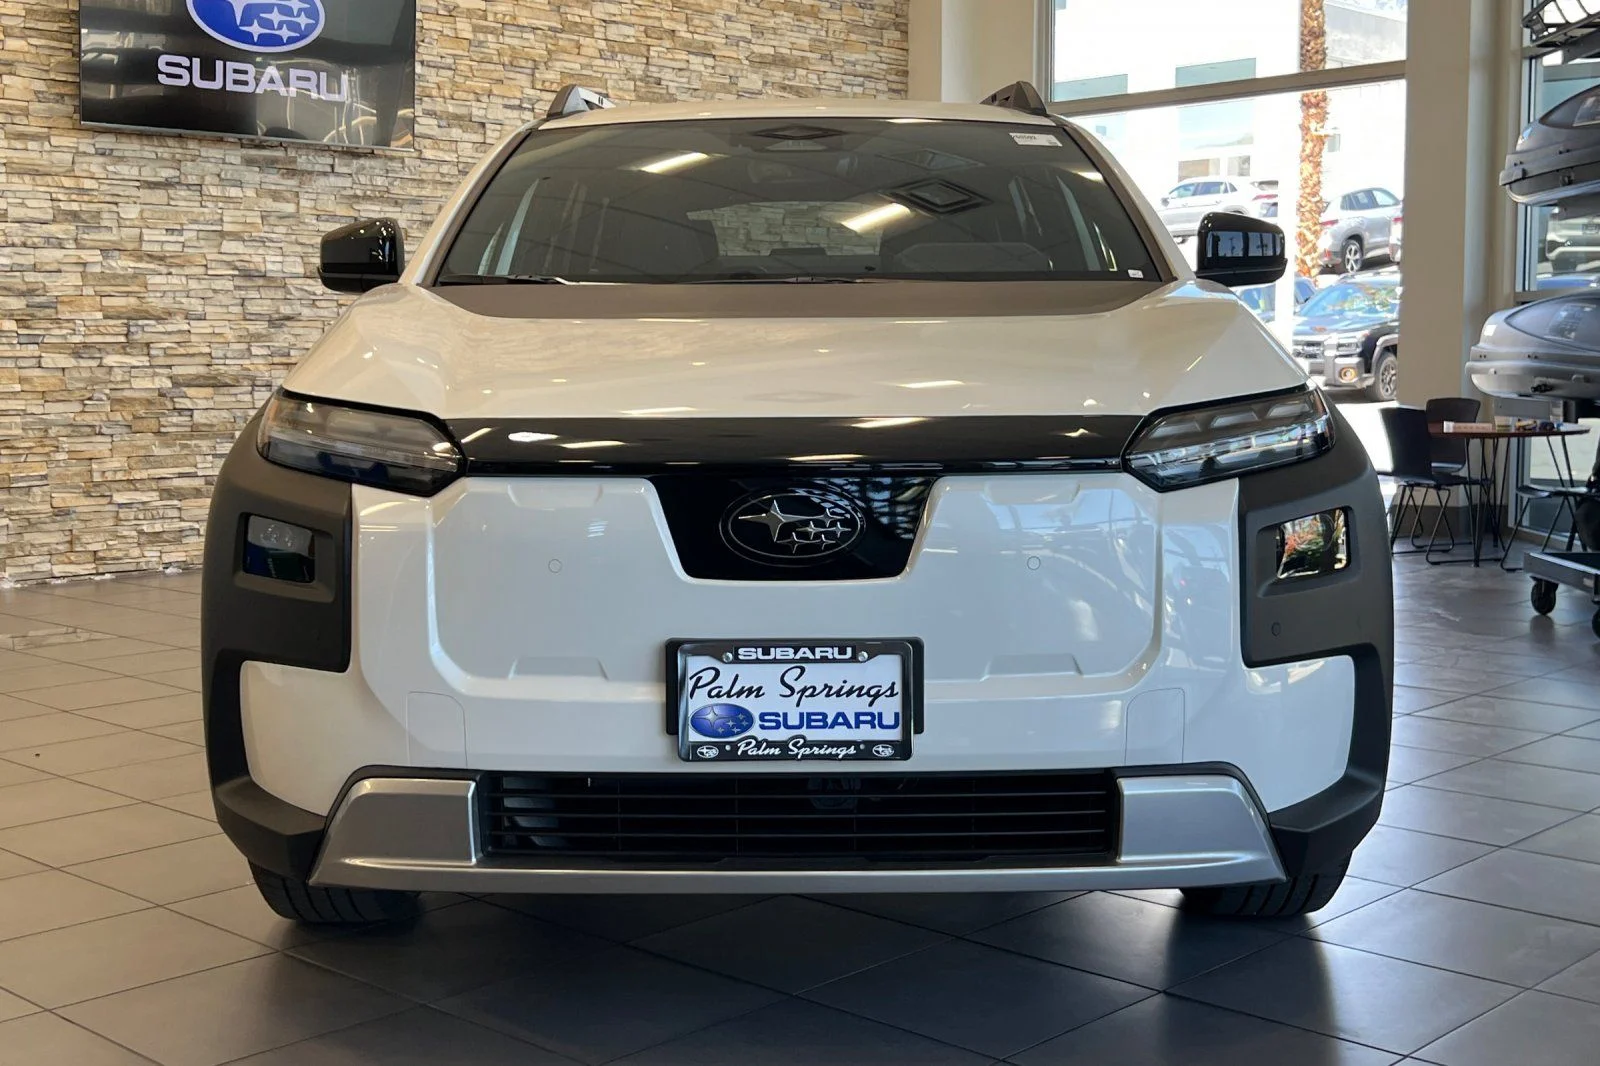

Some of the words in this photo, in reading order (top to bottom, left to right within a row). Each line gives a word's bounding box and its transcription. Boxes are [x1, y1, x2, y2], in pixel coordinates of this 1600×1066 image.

[157, 55, 348, 102] SUBARU
[738, 646, 852, 660] SUBARU
[689, 666, 765, 700] Palm
[779, 665, 899, 708] Springs
[758, 711, 900, 730] SUBARU
[737, 740, 781, 756] Palm
[788, 739, 857, 761] Springs
